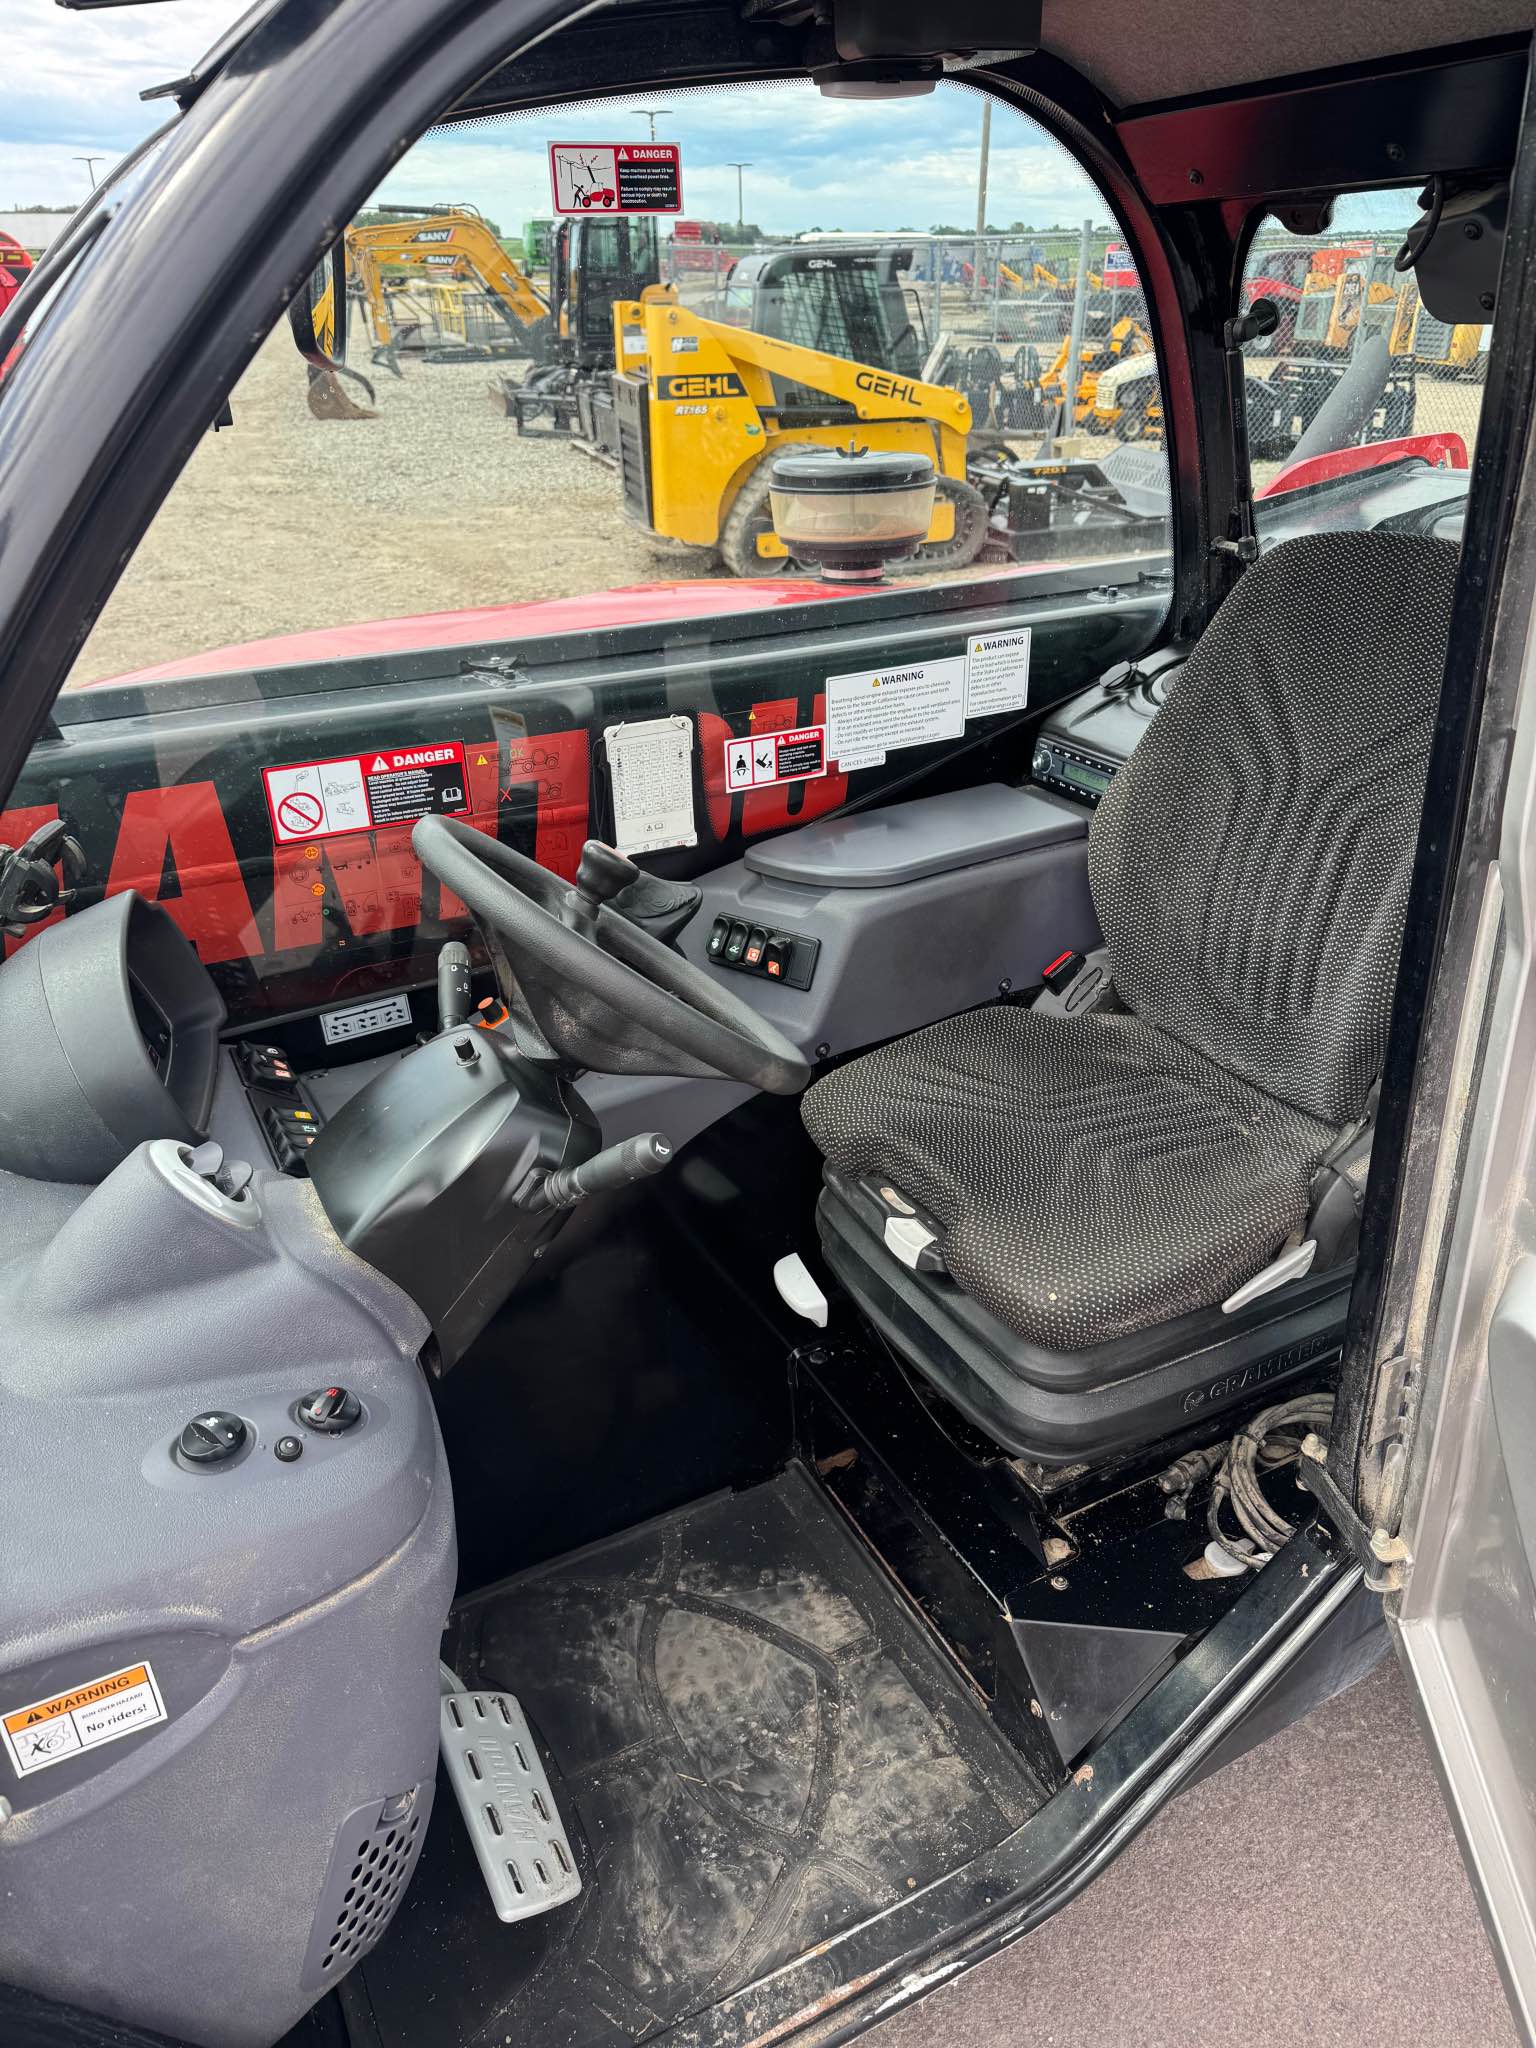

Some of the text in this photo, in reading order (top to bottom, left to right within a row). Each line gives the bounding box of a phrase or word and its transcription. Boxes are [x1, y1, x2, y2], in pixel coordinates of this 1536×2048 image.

[633, 150, 672, 159] DANGER
[808, 259, 837, 269] GEHL
[669, 376, 740, 397] GEHL
[856, 372, 922, 406] GEHL
[984, 637, 1024, 650] WARNING
[881, 671, 924, 685] WARNING
[789, 731, 819, 743] DANGER
[393, 748, 454, 767] DANGER
[46, 1676, 130, 1714] WARNING
[82, 1692, 143, 1719] RUN OVER HAZARD
[86, 1703, 148, 1733] No riders!
